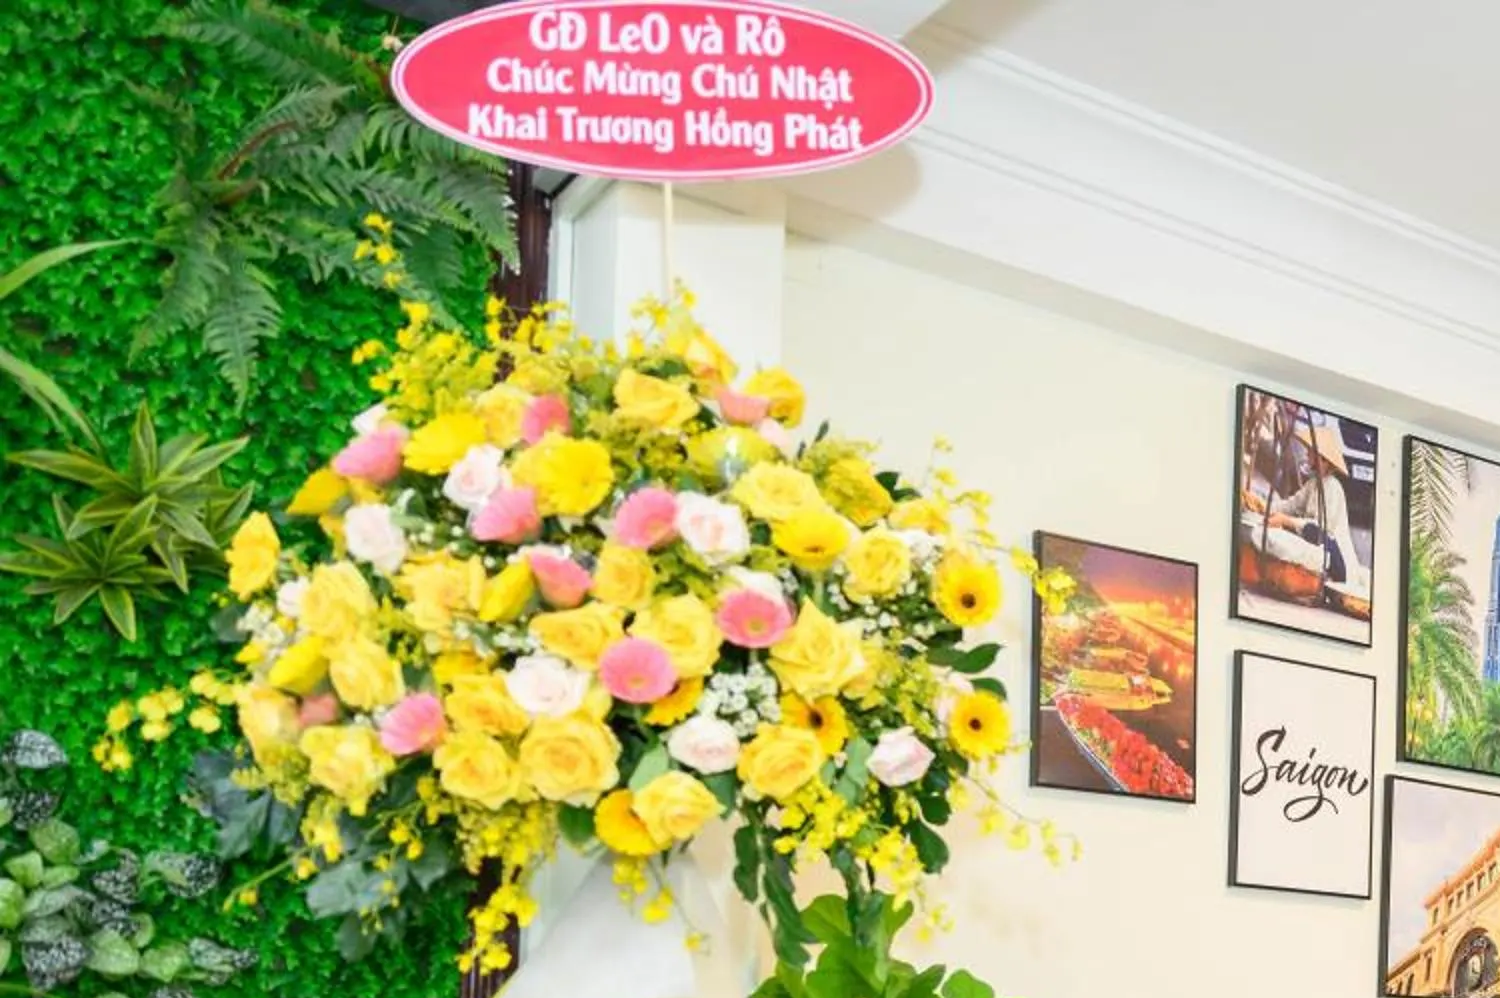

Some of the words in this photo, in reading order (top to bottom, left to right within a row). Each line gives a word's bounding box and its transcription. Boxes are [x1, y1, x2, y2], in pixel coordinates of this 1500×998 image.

[529, 9, 588, 52] GĐ
[680, 14, 724, 55] và
[736, 14, 786, 57] Rô
[486, 56, 574, 94] Chúc
[584, 59, 682, 105] Mừng
[770, 65, 854, 110] Nhật
[467, 103, 548, 141] Khai
[555, 106, 675, 154] Trương
[784, 113, 863, 151] Phát
[1241, 725, 1368, 822] Saigon
